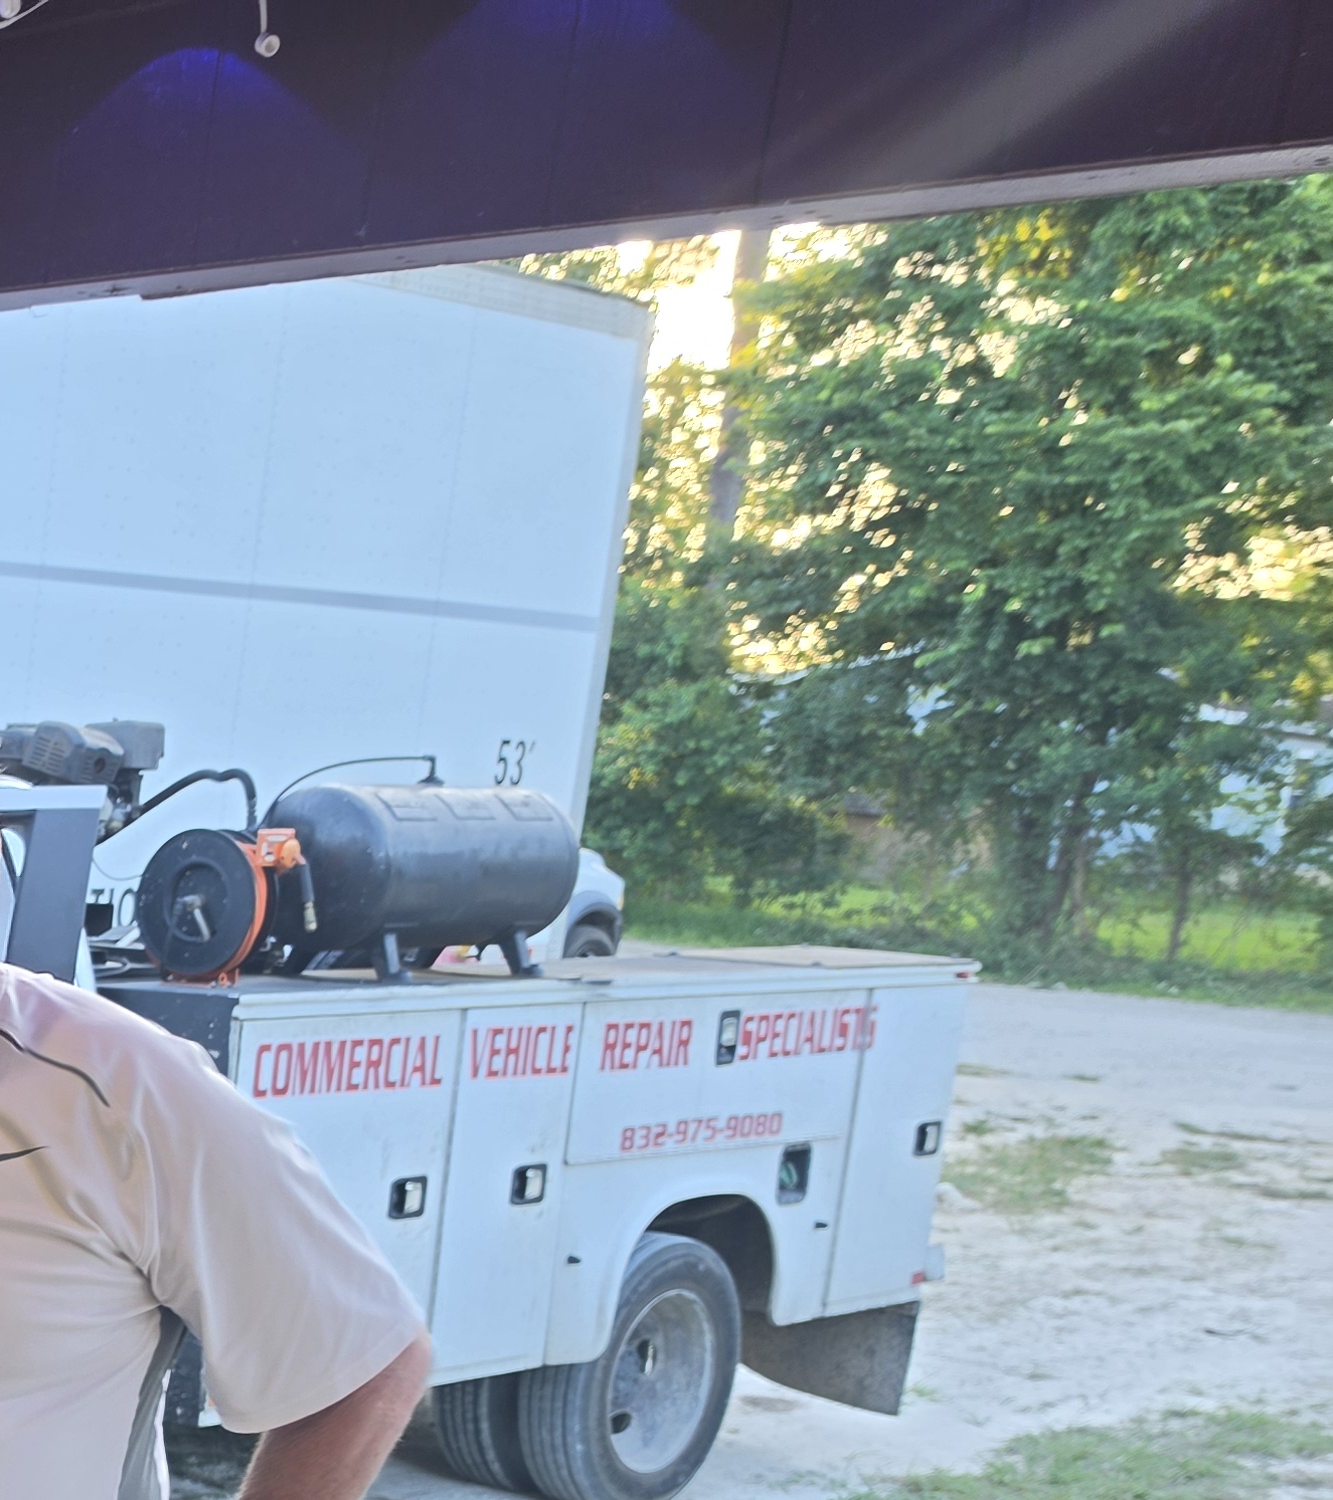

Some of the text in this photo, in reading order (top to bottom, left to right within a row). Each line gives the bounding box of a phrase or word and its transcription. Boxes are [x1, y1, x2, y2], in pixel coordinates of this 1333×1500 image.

[252, 1034, 443, 1100] COMMERCIAL
[469, 1024, 575, 1079] VEHICLE
[599, 1018, 694, 1073] REPAIR
[619, 1111, 783, 1152] 832-975-9080
